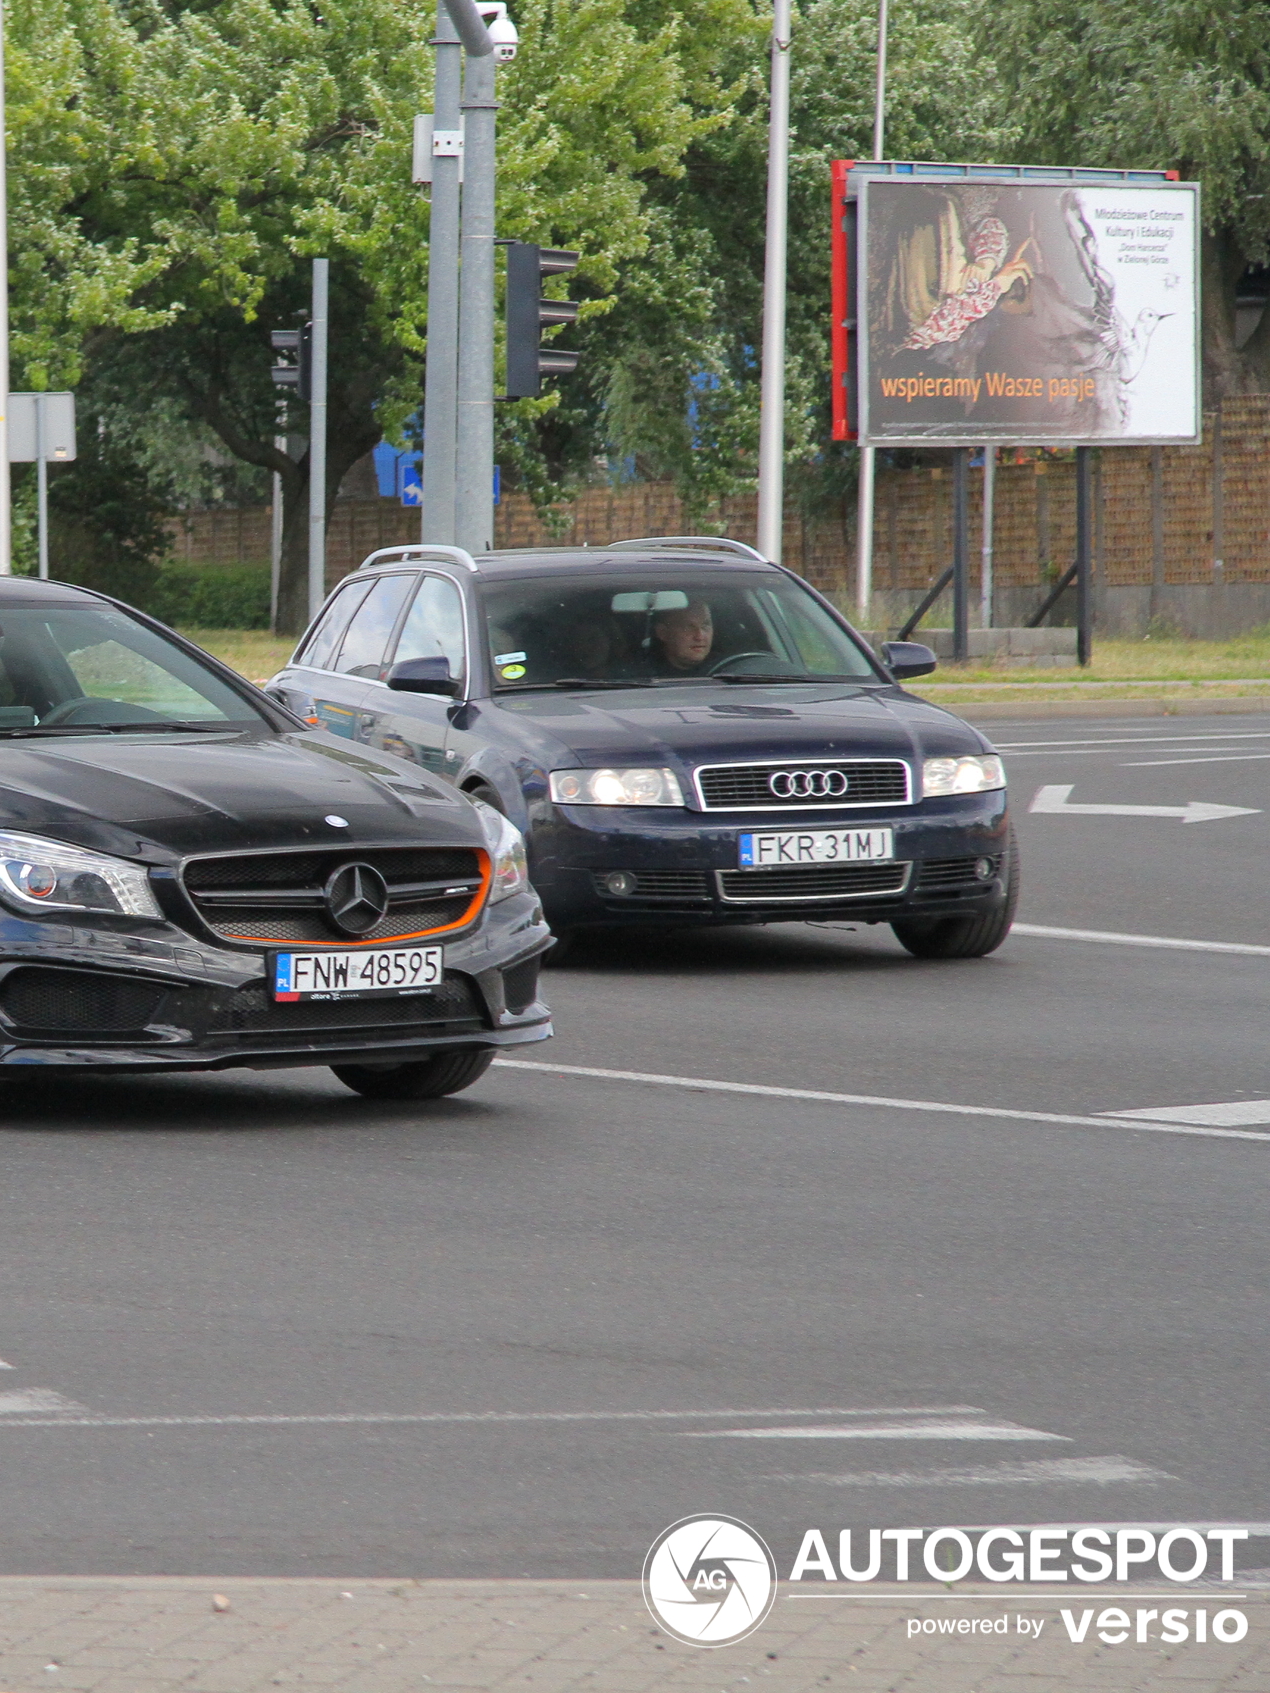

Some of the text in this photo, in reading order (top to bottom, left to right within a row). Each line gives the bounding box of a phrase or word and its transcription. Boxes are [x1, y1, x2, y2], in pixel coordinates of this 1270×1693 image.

[1150, 209, 1184, 221] Centrum
[881, 372, 1095, 403] wspieramy Wasze pasje
[758, 832, 885, 862] FKR 31MJ
[277, 978, 289, 988] PL
[294, 951, 437, 989] FNW 48595
